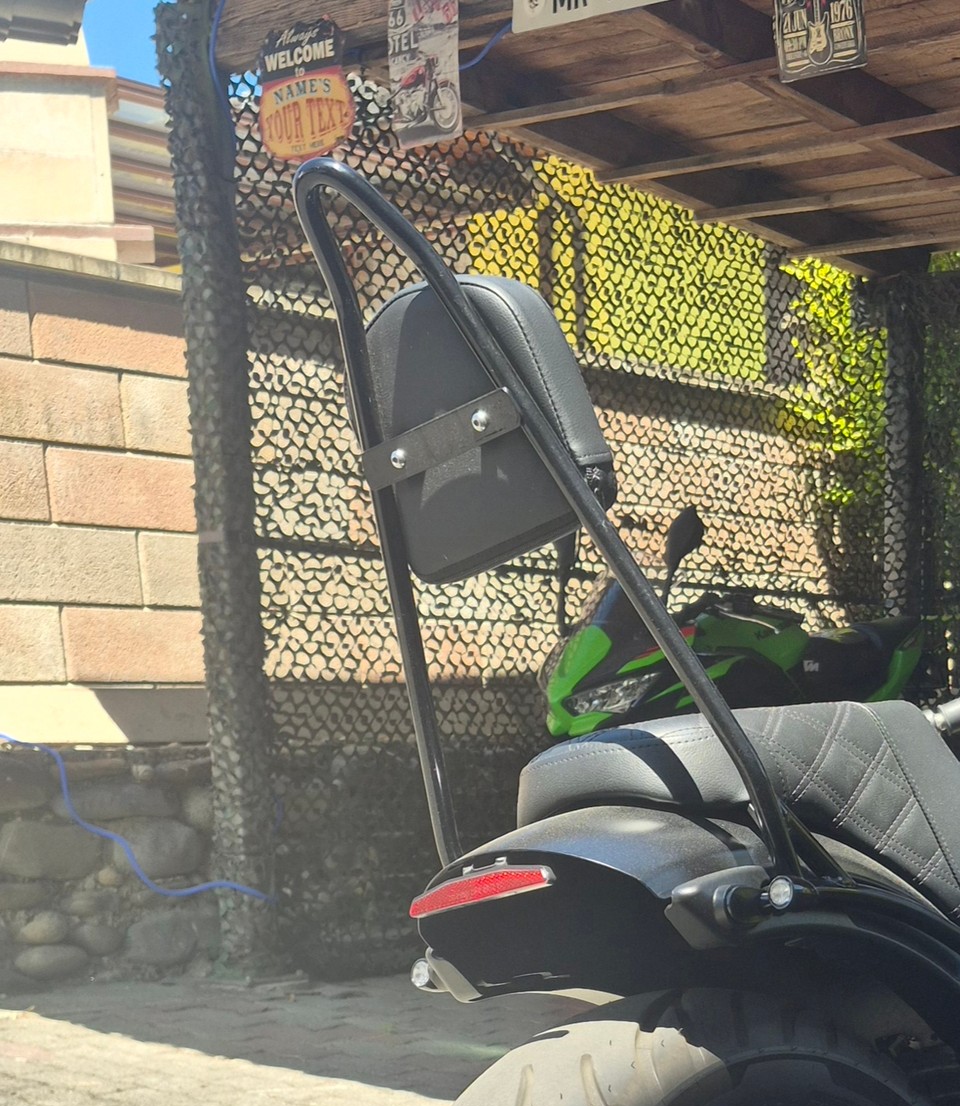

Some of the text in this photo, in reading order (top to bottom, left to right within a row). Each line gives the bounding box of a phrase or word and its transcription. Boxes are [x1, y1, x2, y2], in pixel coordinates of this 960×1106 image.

[388, 10, 404, 28] 66
[830, 0, 854, 23] 1976
[275, 27, 320, 49] Always
[264, 38, 335, 73] WELCOME
[294, 66, 306, 78] to
[273, 78, 331, 105] NAME'S
[266, 101, 305, 145] YOUR
